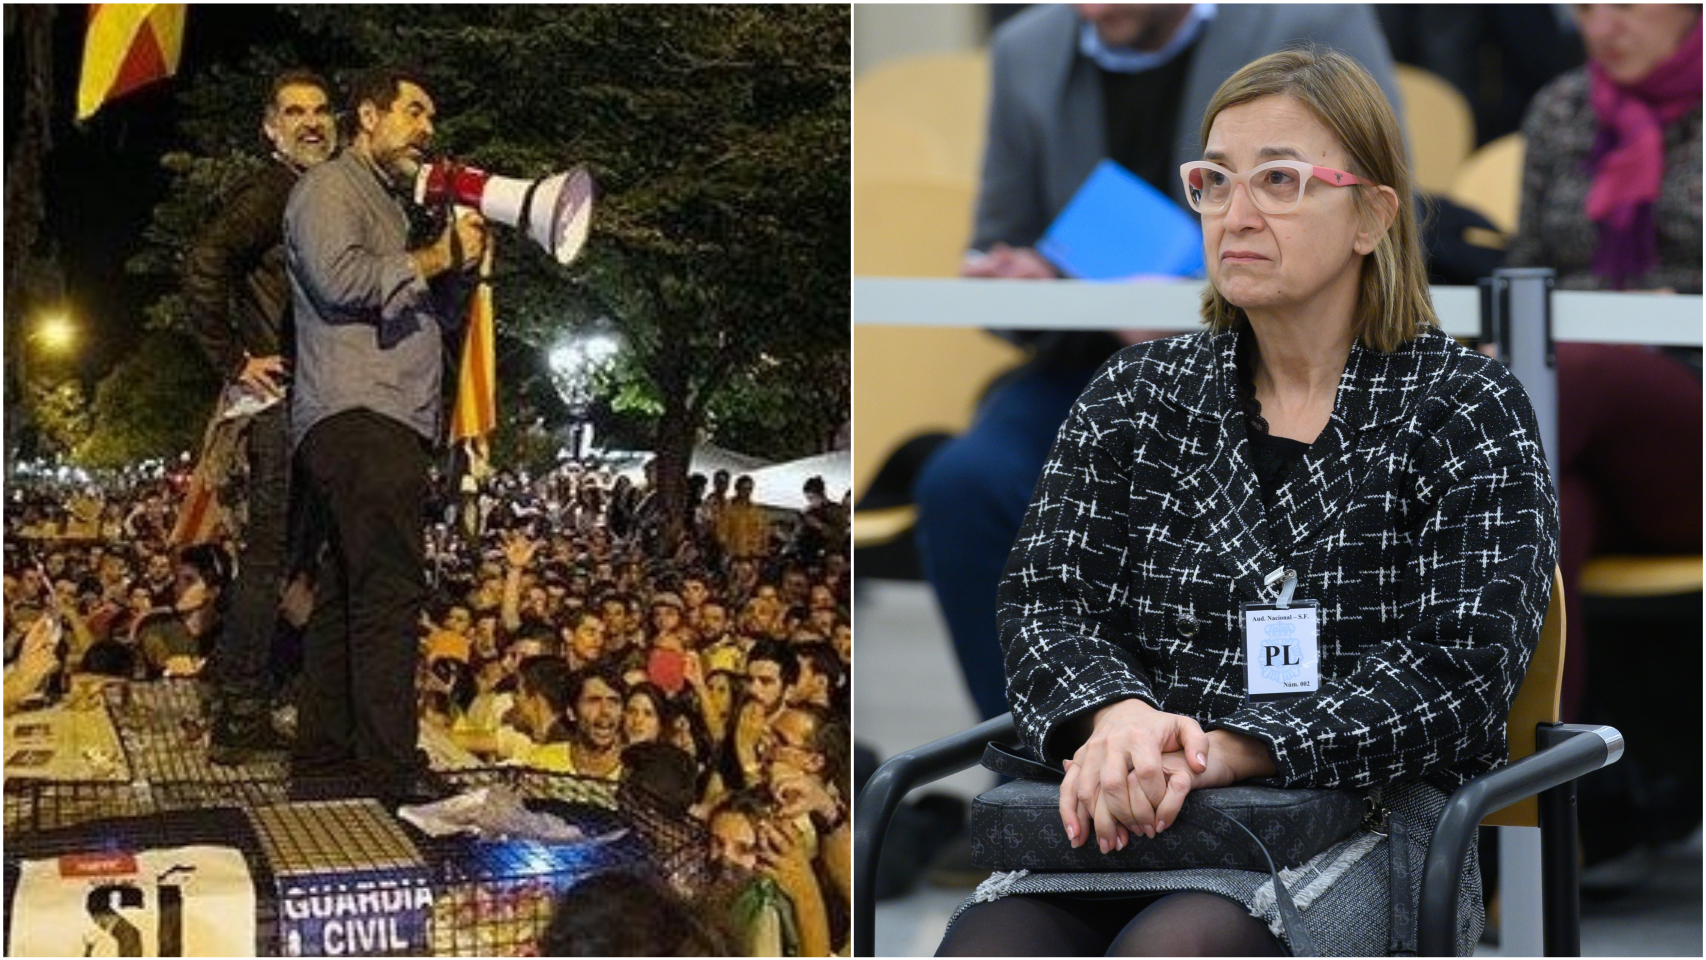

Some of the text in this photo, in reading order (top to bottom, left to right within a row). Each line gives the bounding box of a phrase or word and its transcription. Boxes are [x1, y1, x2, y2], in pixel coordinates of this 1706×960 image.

[1264, 645, 1300, 666] PL
[83, 865, 197, 957] SÍ
[284, 878, 434, 919] GUARDIA
[323, 917, 409, 956] CIVIL
